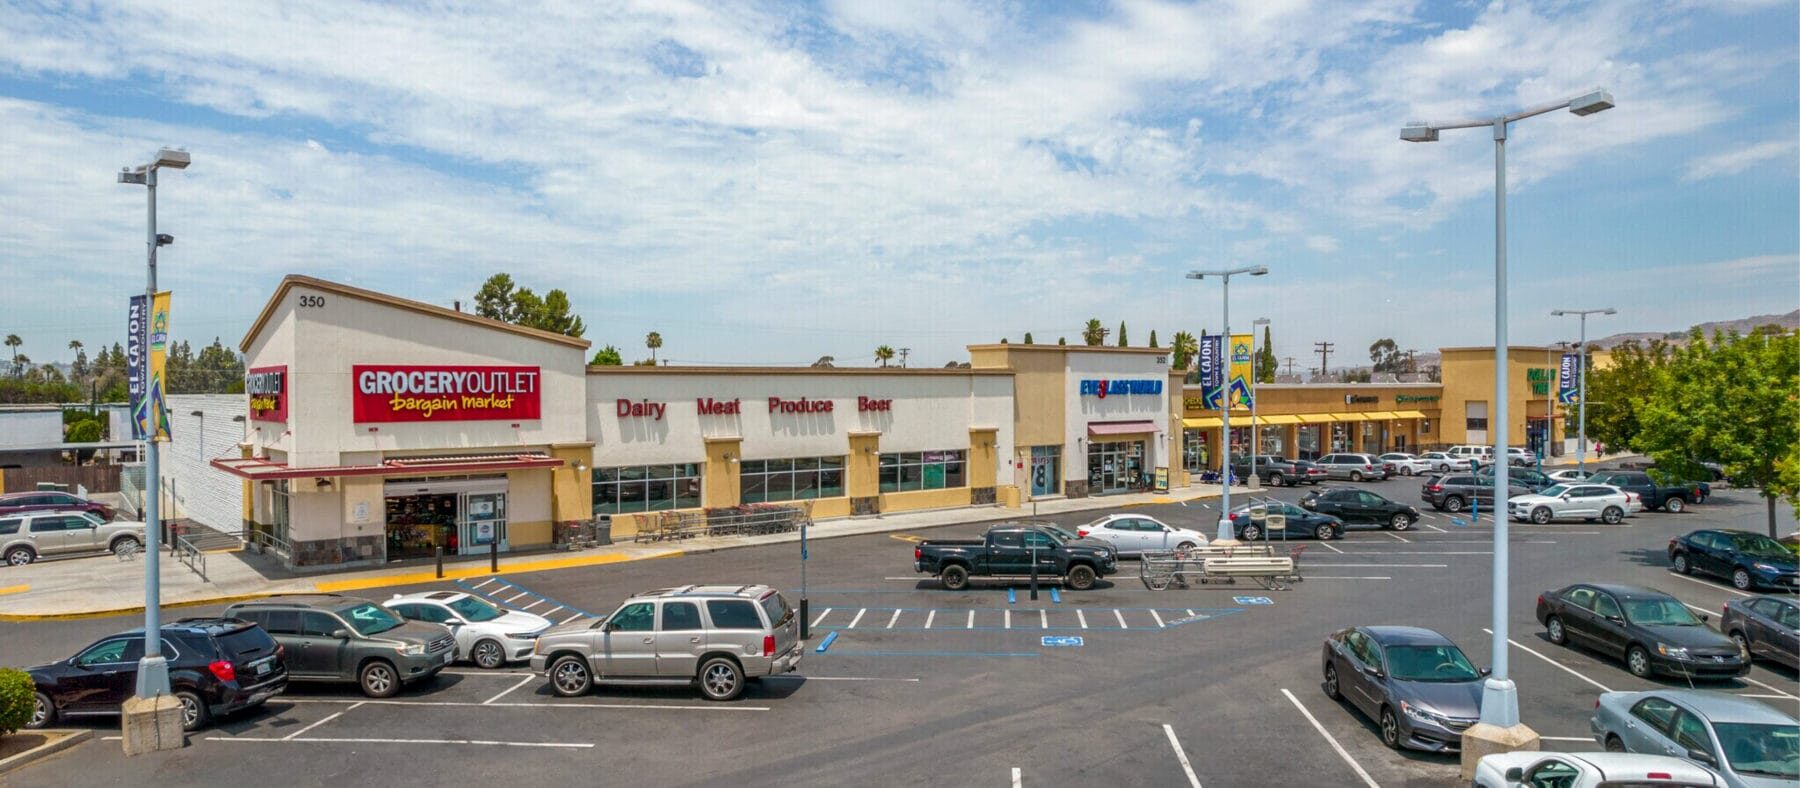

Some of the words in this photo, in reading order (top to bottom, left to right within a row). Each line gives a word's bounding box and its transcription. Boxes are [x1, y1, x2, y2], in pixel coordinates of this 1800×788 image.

[299, 295, 325, 308] 350
[129, 304, 140, 367] CAJON
[1201, 340, 1212, 373] CAJON
[1561, 356, 1571, 379] CAJON
[129, 372, 140, 395] EL
[1202, 373, 1212, 387] EL
[1561, 380, 1570, 388] EL
[389, 393, 457, 418] bargain
[462, 394, 514, 409] market
[616, 399, 666, 420] Dairy
[697, 398, 741, 415] Meat
[768, 396, 834, 414] Produce
[857, 396, 893, 412] Beer
